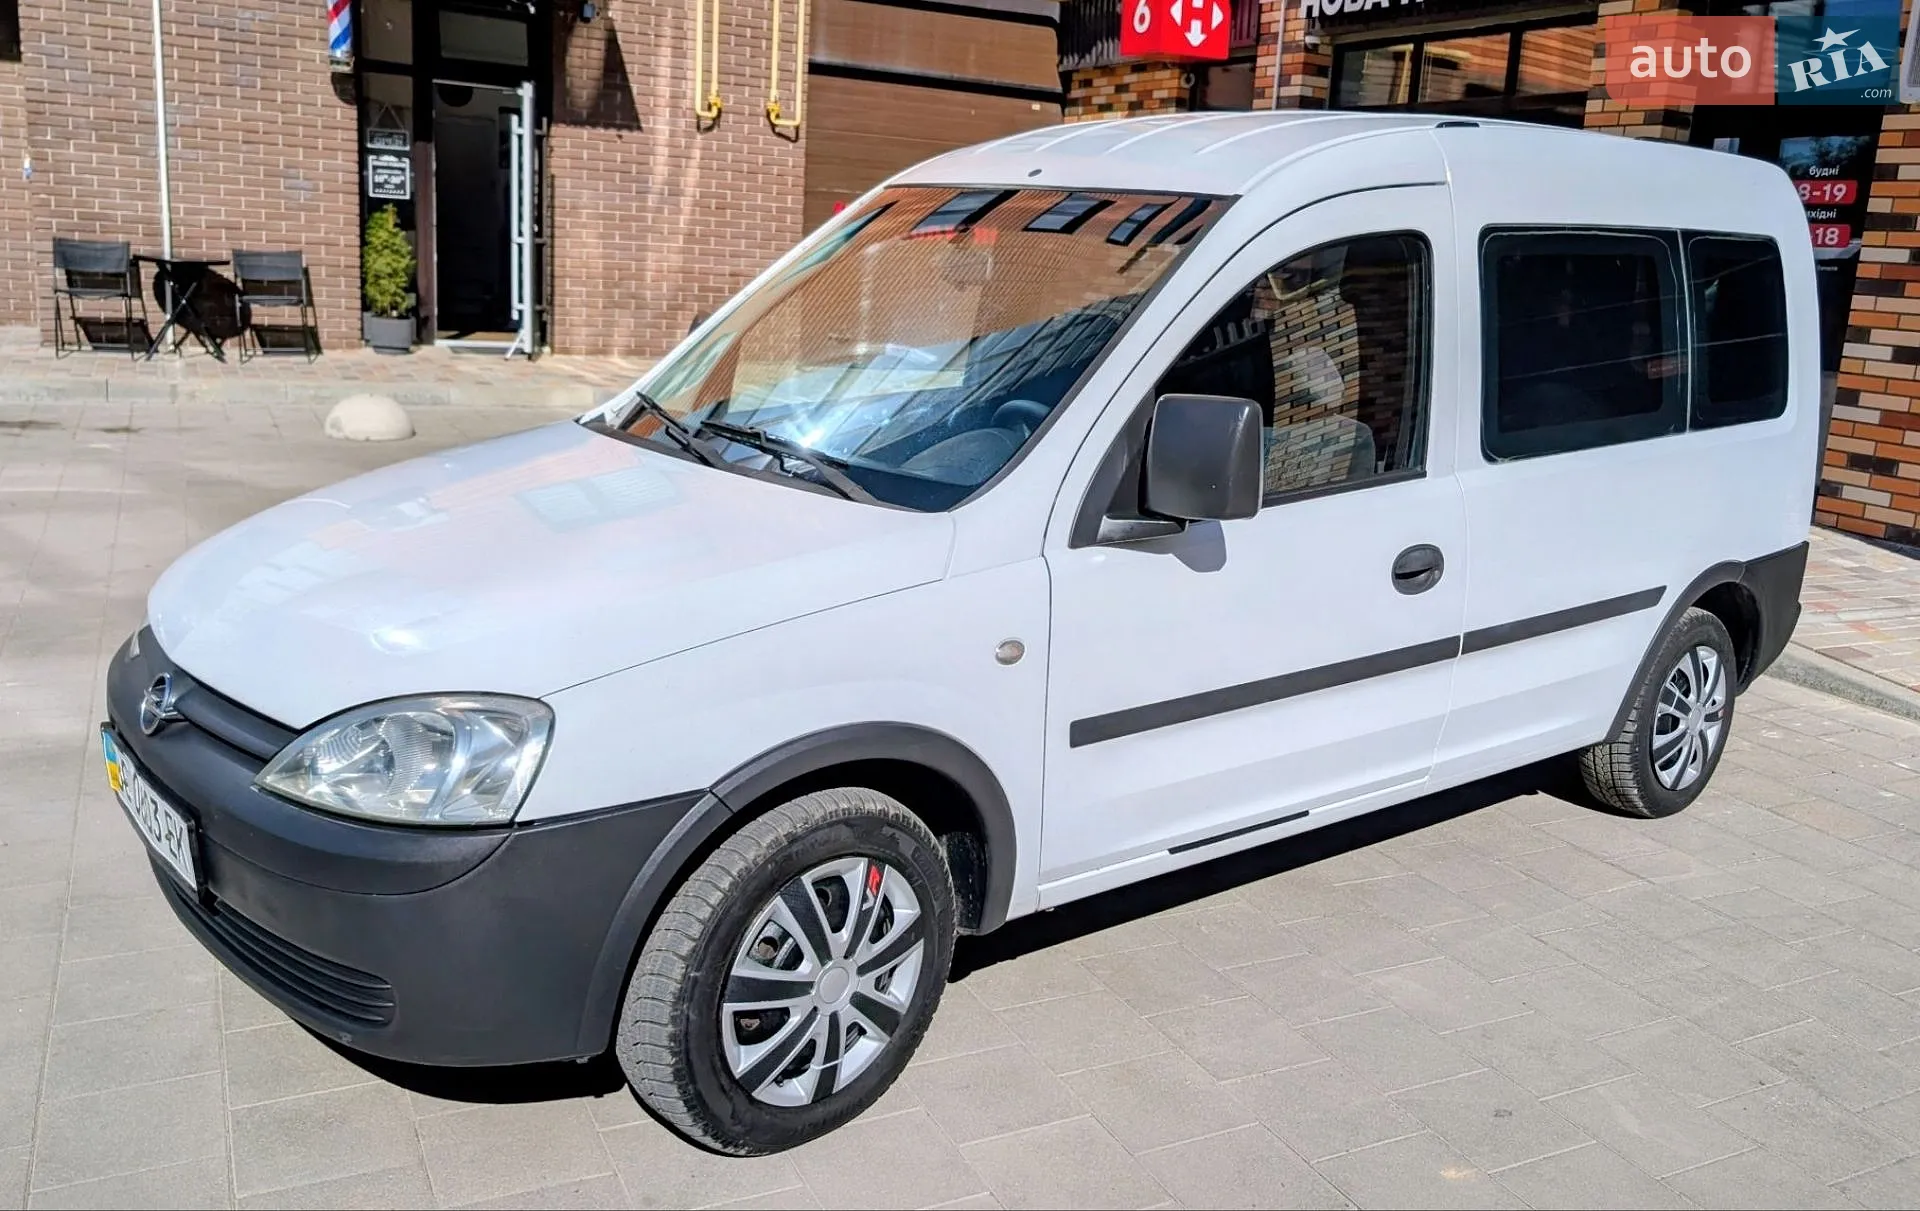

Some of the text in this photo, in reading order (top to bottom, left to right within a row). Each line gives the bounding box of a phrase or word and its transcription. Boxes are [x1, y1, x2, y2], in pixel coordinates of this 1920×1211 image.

[1133, 0, 1151, 34] 6
[1809, 165, 1839, 177] будні
[1798, 183, 1847, 202] 8-19
